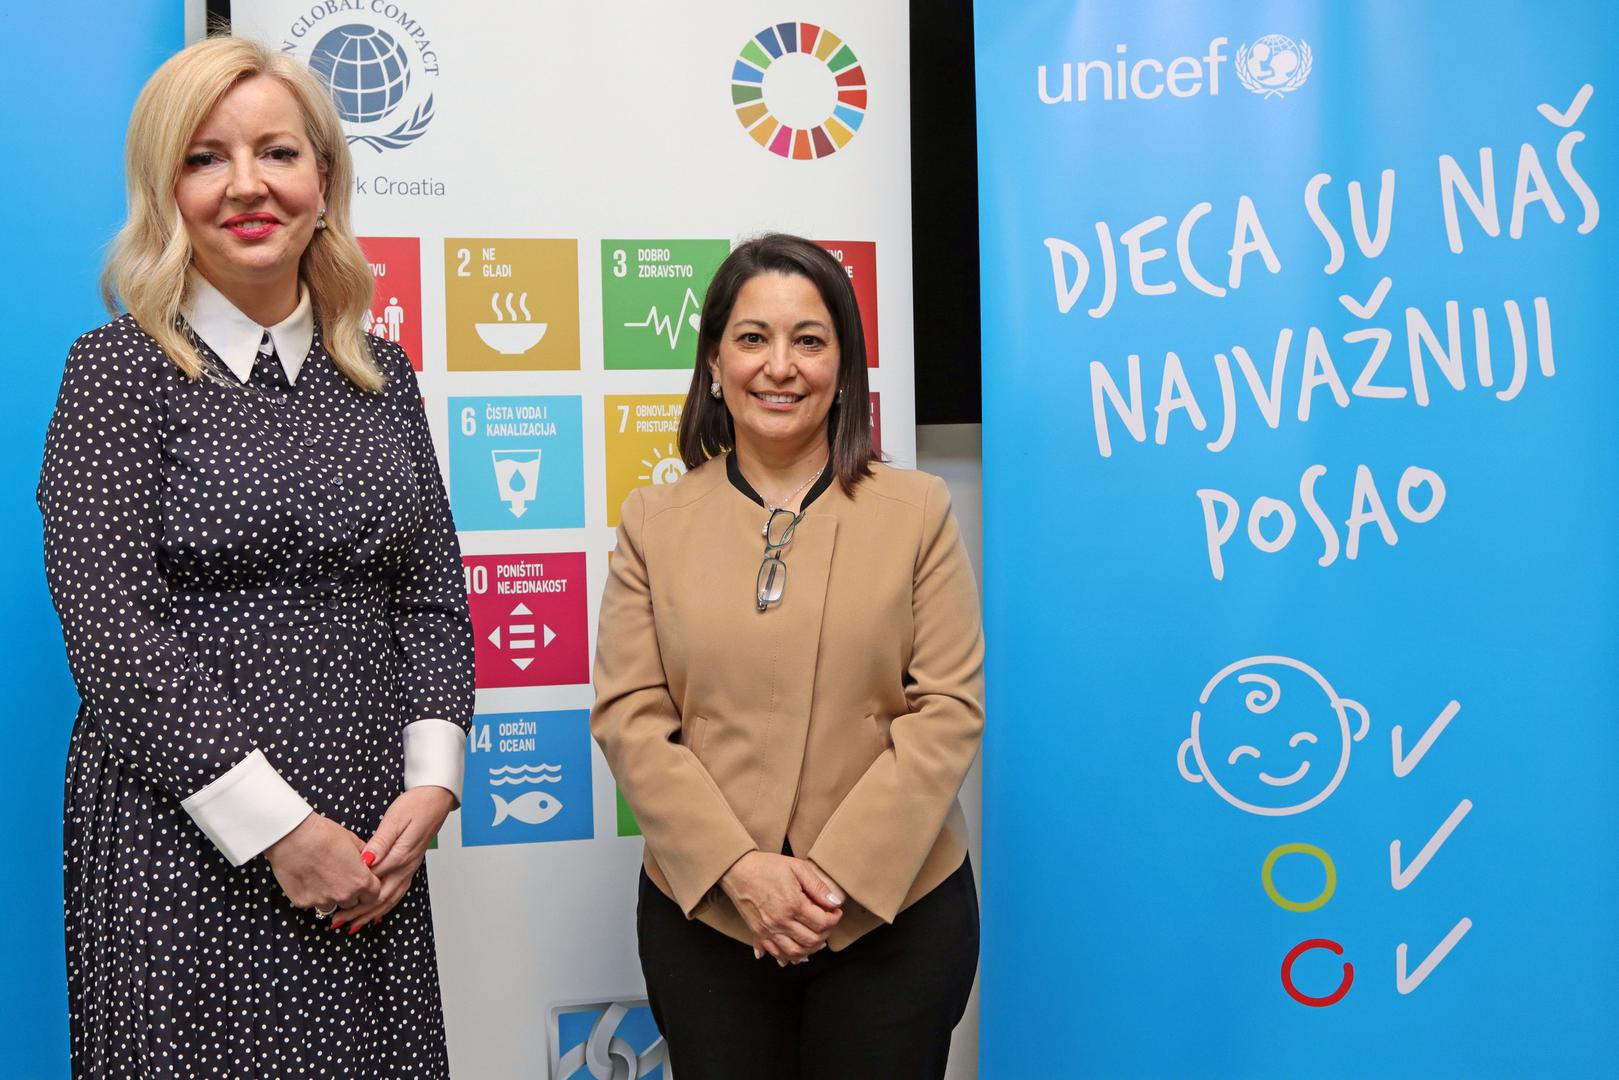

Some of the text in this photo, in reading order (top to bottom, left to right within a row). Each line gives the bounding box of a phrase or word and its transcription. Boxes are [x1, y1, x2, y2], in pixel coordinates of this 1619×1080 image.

[291, 0, 365, 38] GLOBAL
[371, 0, 440, 77] COMPACT
[1037, 37, 1228, 104] unicef
[374, 176, 445, 196] Croatia
[1043, 83, 1600, 318] DJECA SU NAŠ
[457, 248, 471, 277] 2
[482, 248, 496, 261] NE
[613, 249, 627, 278] 3
[638, 248, 670, 262] DOBRO
[482, 264, 512, 278] GLADI
[638, 265, 694, 278] ZDRAVSTVO
[1089, 277, 1556, 458] NAJVAŽNIJI
[461, 407, 476, 436] 6
[486, 403, 547, 420] ČISTA VODA I
[616, 405, 630, 433] 7
[486, 422, 557, 437] KANALIZACIJA
[636, 416, 680, 433] PRISTUPAČ
[1196, 464, 1447, 581] POSAO
[496, 560, 544, 578] PONIŠTITI
[464, 565, 488, 595] 10
[497, 579, 567, 595] NEJEDNAKOST
[498, 718, 537, 736] ODRŽIVI
[470, 724, 492, 753] 14
[499, 738, 536, 753] OCEANI
